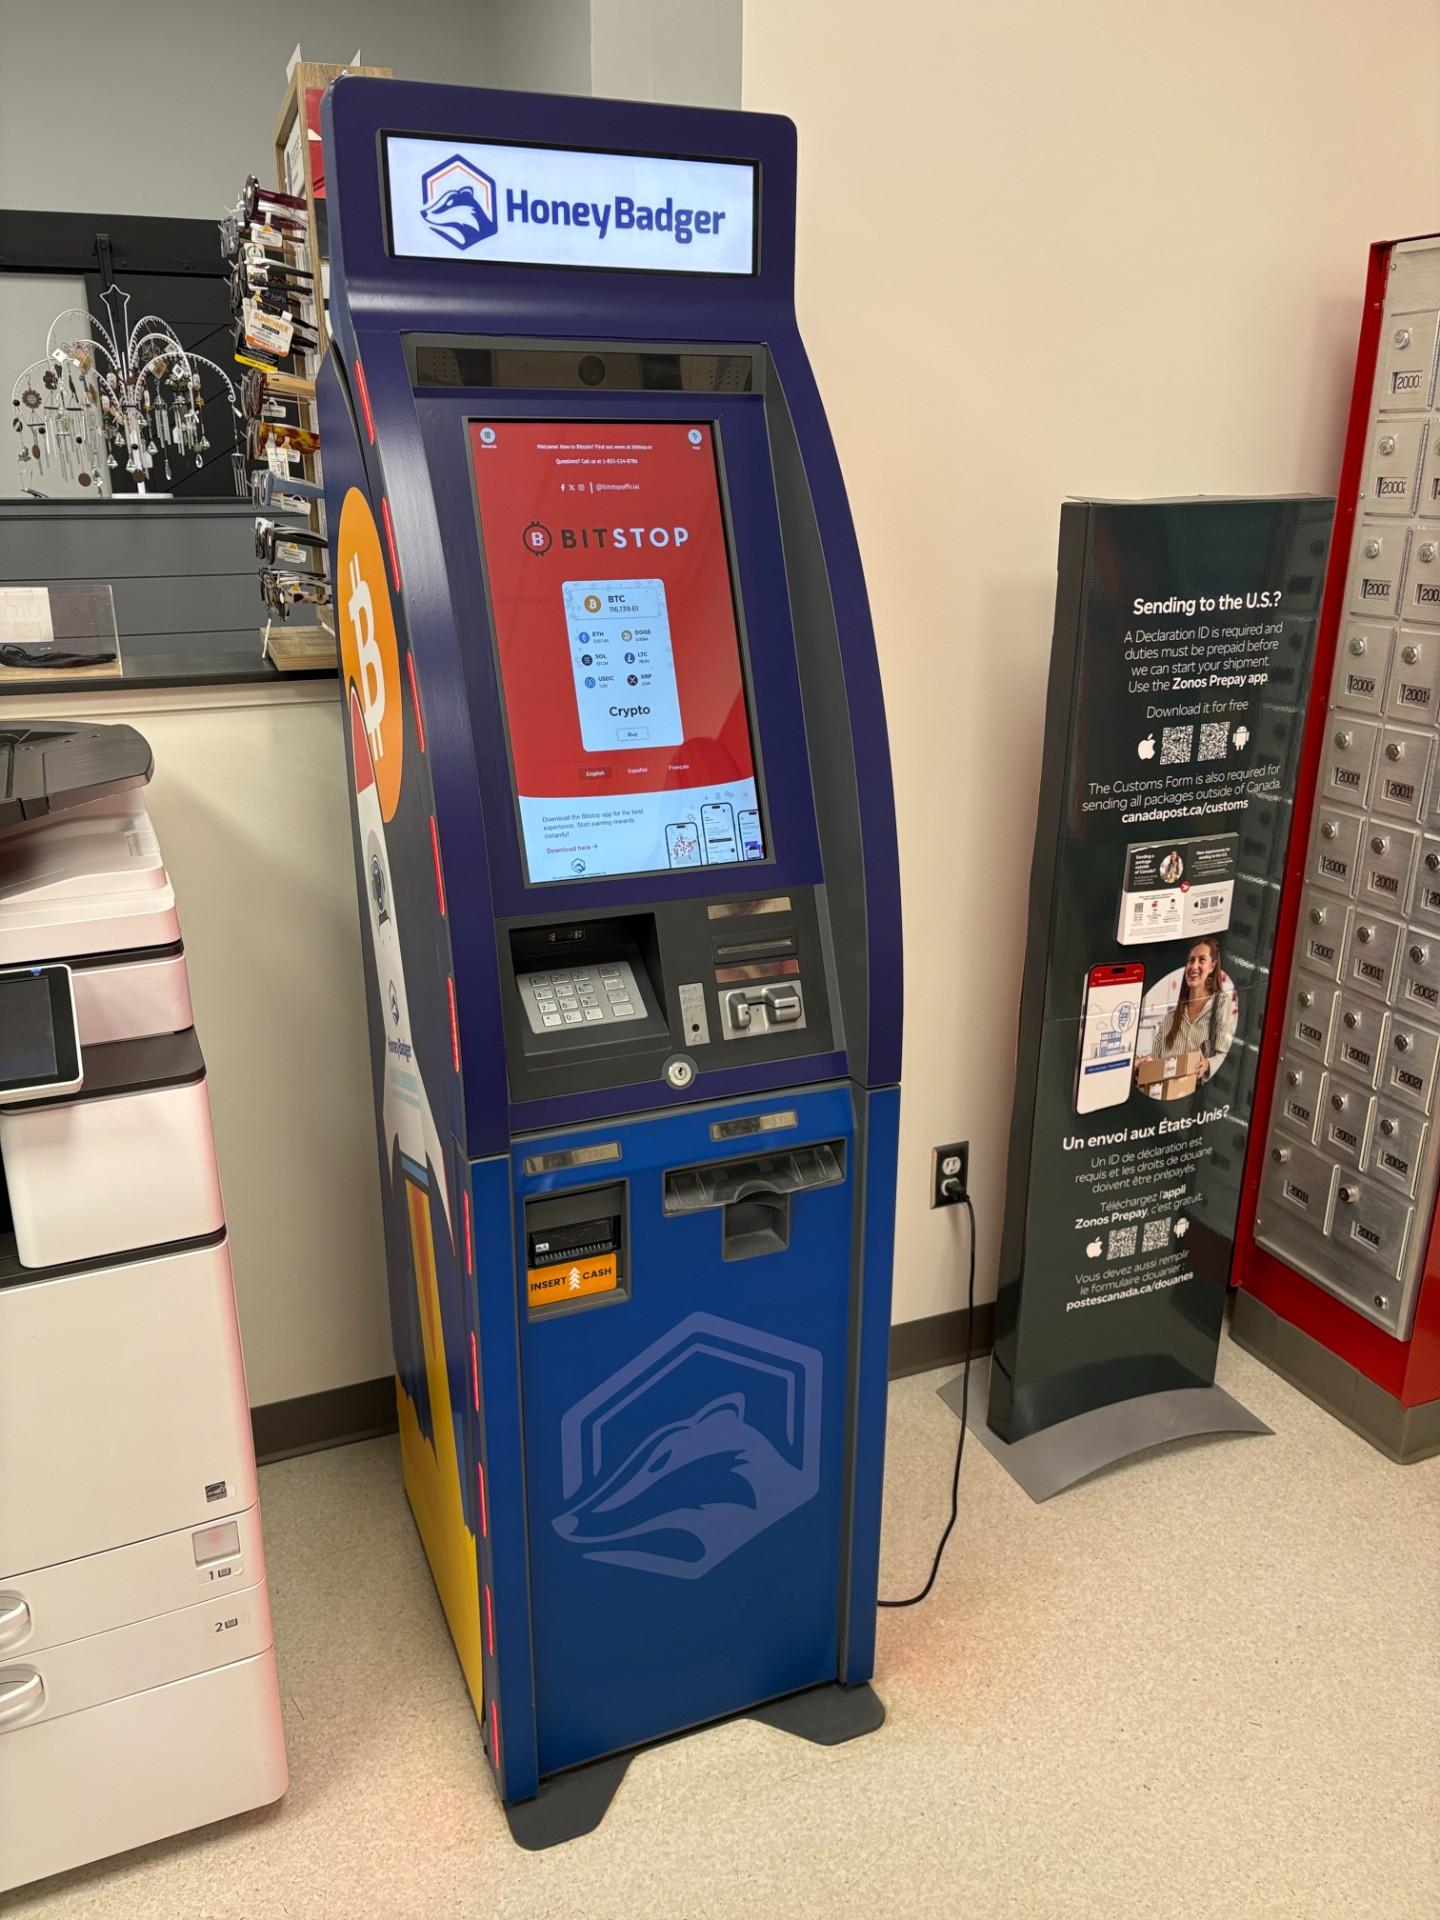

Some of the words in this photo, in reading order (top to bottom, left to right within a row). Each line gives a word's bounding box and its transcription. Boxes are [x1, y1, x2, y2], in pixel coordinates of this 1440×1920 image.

[506, 188, 726, 244] HoneyBadger
[1396, 375, 1422, 390] 2000
[561, 528, 689, 549] BITSTOP
[608, 595, 626, 603] BTC
[1133, 597, 1196, 616] Sending
[1200, 596, 1215, 612] to
[1218, 594, 1243, 610] the
[1246, 591, 1282, 609] U.S.?
[1124, 631, 1133, 643] A
[1136, 628, 1195, 643] Declaration
[1198, 626, 1210, 640] ID
[1212, 626, 1220, 638] is
[1222, 623, 1263, 640] required
[1265, 621, 1283, 635] and
[1125, 647, 1159, 661] duties
[1161, 646, 1188, 658] must
[1191, 644, 1205, 656] be
[1206, 641, 1245, 658] prepaid
[1247, 640, 1279, 652] before
[1131, 666, 1148, 676] we
[1150, 664, 1169, 675] can
[1172, 662, 1195, 674] start
[1197, 661, 1220, 675] your
[1223, 656, 1270, 672] shipment.
[1128, 680, 1149, 694] Use
[1152, 678, 1170, 691] the
[1172, 677, 1207, 690] Zonos
[1210, 674, 1246, 688] Prepay
[609, 705, 650, 718] Crypto
[1146, 704, 1200, 719] Download
[1203, 703, 1210, 714] it
[1212, 701, 1227, 713] for
[1229, 699, 1249, 711] free
[1088, 782, 1110, 795] The
[1112, 778, 1163, 794] Customs
[1165, 775, 1193, 789] Form
[1195, 773, 1203, 785] is
[1206, 772, 1225, 784] also
[1226, 766, 1265, 783] required
[1268, 764, 1281, 776] for
[1082, 798, 1127, 812] sending
[1130, 794, 1141, 806] all
[1144, 791, 1194, 809] packages
[1196, 786, 1232, 800] outside
[1234, 784, 1245, 796] of
[1122, 799, 1249, 824] canadapost.ca/customs
[1063, 1136, 1084, 1150] Un
[1088, 1128, 1127, 1148] envoi
[1130, 1126, 1155, 1140] aux
[1158, 1104, 1230, 1135] États-Unis?
[1091, 1156, 1106, 1168] Un
[1108, 1154, 1120, 1166] ID
[1122, 1151, 1135, 1163] de
[1137, 1142, 1187, 1160] déclaration
[1188, 1137, 1203, 1148] est
[1075, 1170, 1107, 1184] requis
[1108, 1168, 1120, 1178] et
[1121, 1164, 1135, 1176] les
[1137, 1158, 1165, 1173] droits
[1166, 1155, 1179, 1166] de
[1180, 1147, 1213, 1163] douane
[1092, 1179, 1130, 1194] doivent
[1132, 1172, 1152, 1187] être
[1100, 1193, 1157, 1213] Téléchargez
[1074, 1216, 1109, 1230] Zonos
[530, 1276, 567, 1291] INSERT
[582, 1266, 612, 1280] CASH
[1075, 1273, 1100, 1285] Vous
[1103, 1265, 1132, 1280] devez
[1134, 1261, 1157, 1272] aussi
[1158, 1250, 1190, 1266] remplir
[1066, 1271, 1194, 1312] postescanada.ca/douanes
[1080, 1285, 1090, 1296] le
[1091, 1275, 1140, 1294] formulaire
[1142, 1265, 1182, 1281] douanier
[208, 1571, 214, 1580] 1
[215, 1622, 223, 1632] 2
